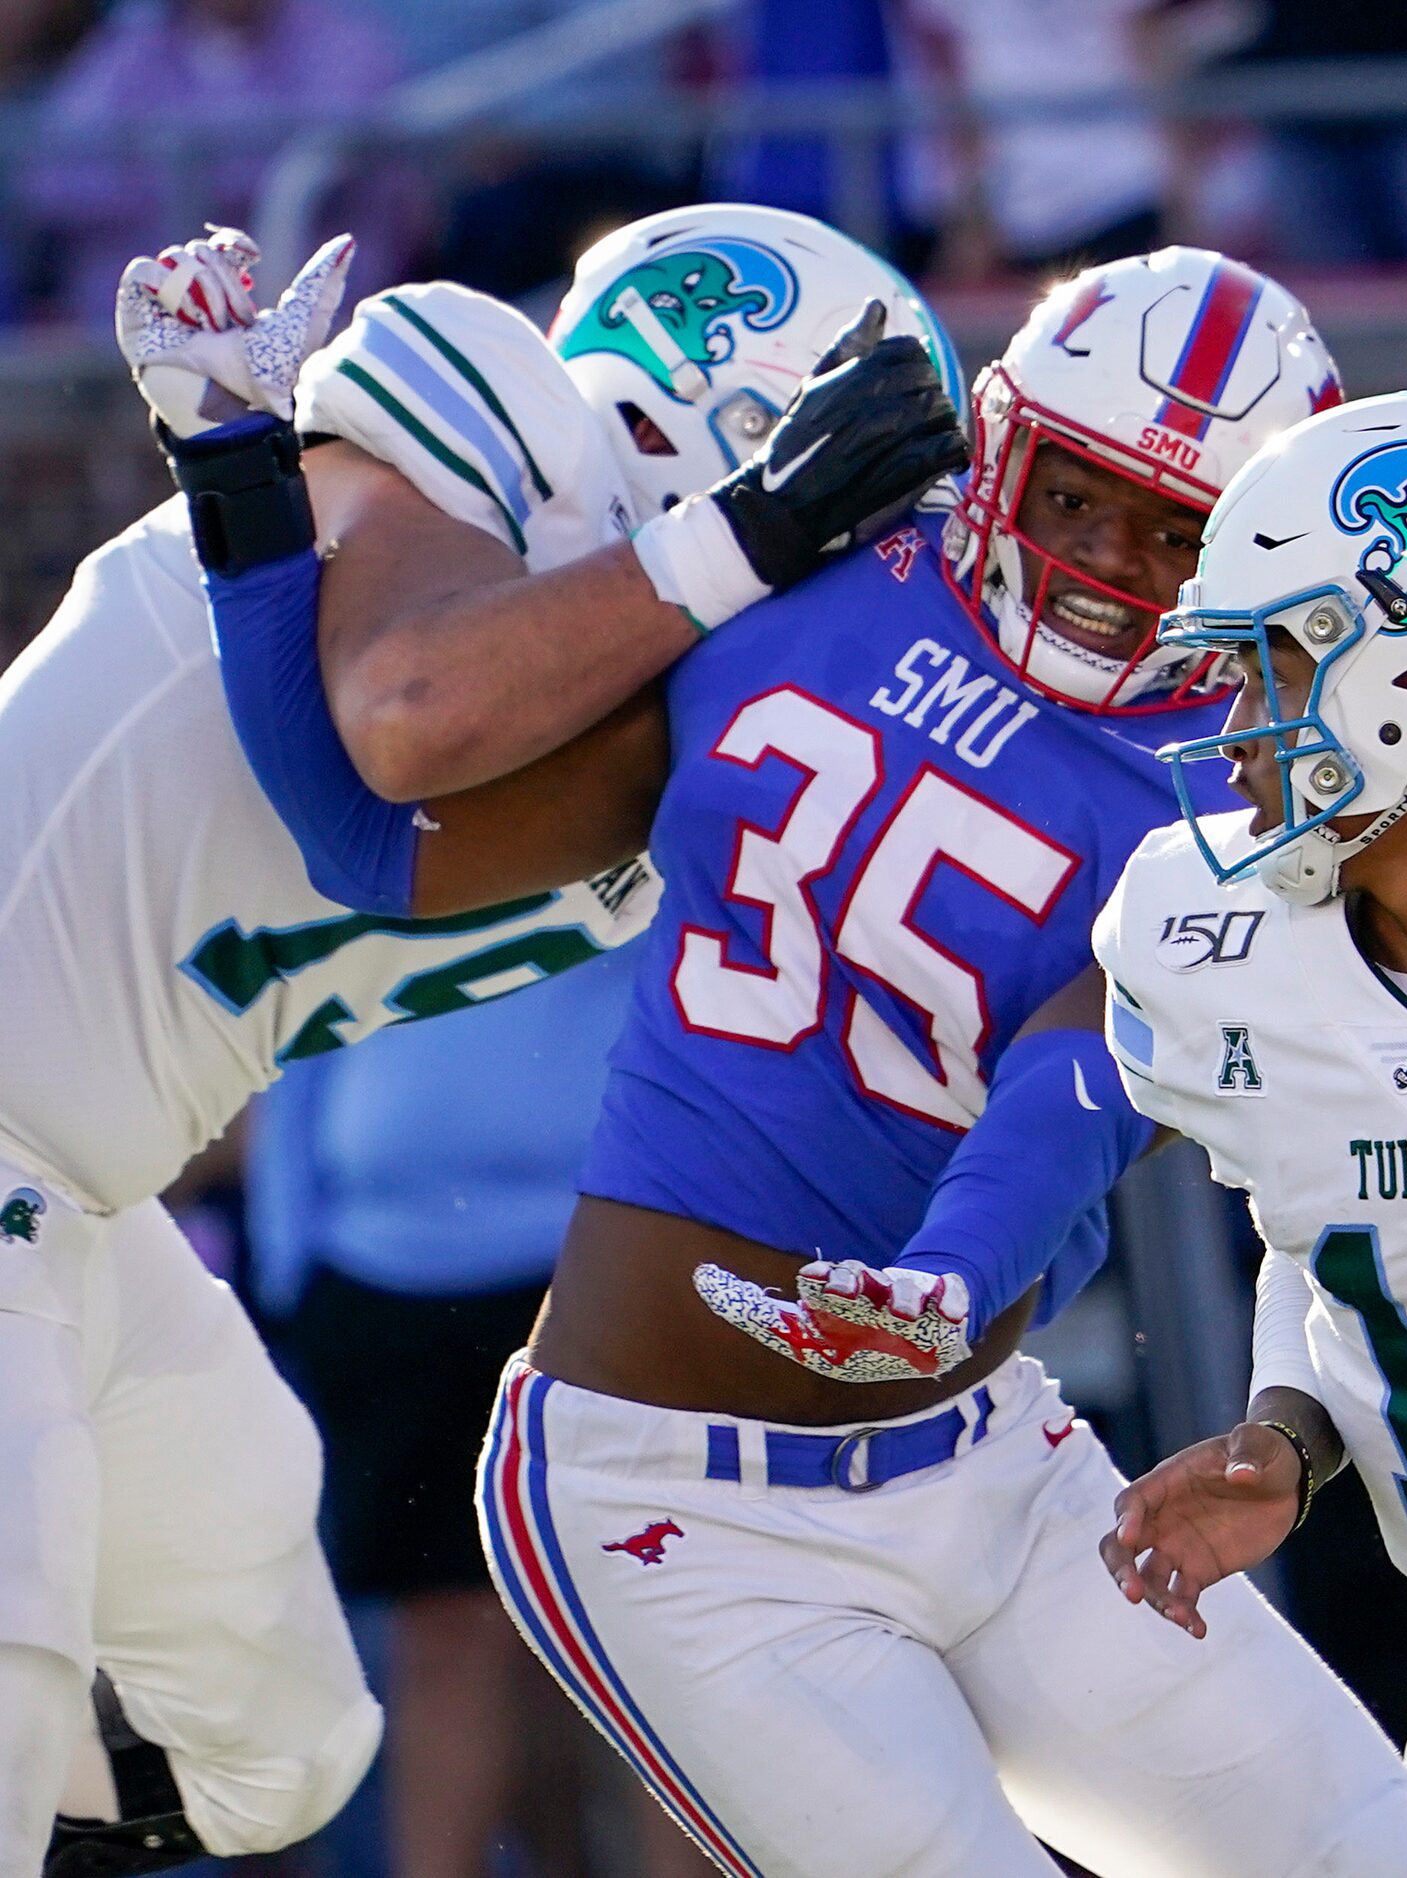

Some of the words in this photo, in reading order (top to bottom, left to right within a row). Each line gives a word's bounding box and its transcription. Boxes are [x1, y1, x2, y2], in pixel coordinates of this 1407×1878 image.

[1137, 427, 1201, 470] SMU
[869, 638, 1040, 769] SMU
[1360, 803, 1406, 845] SPORT
[669, 682, 1084, 1138] 35
[1160, 911, 1266, 969] 150
[1218, 1027, 1262, 1090] A
